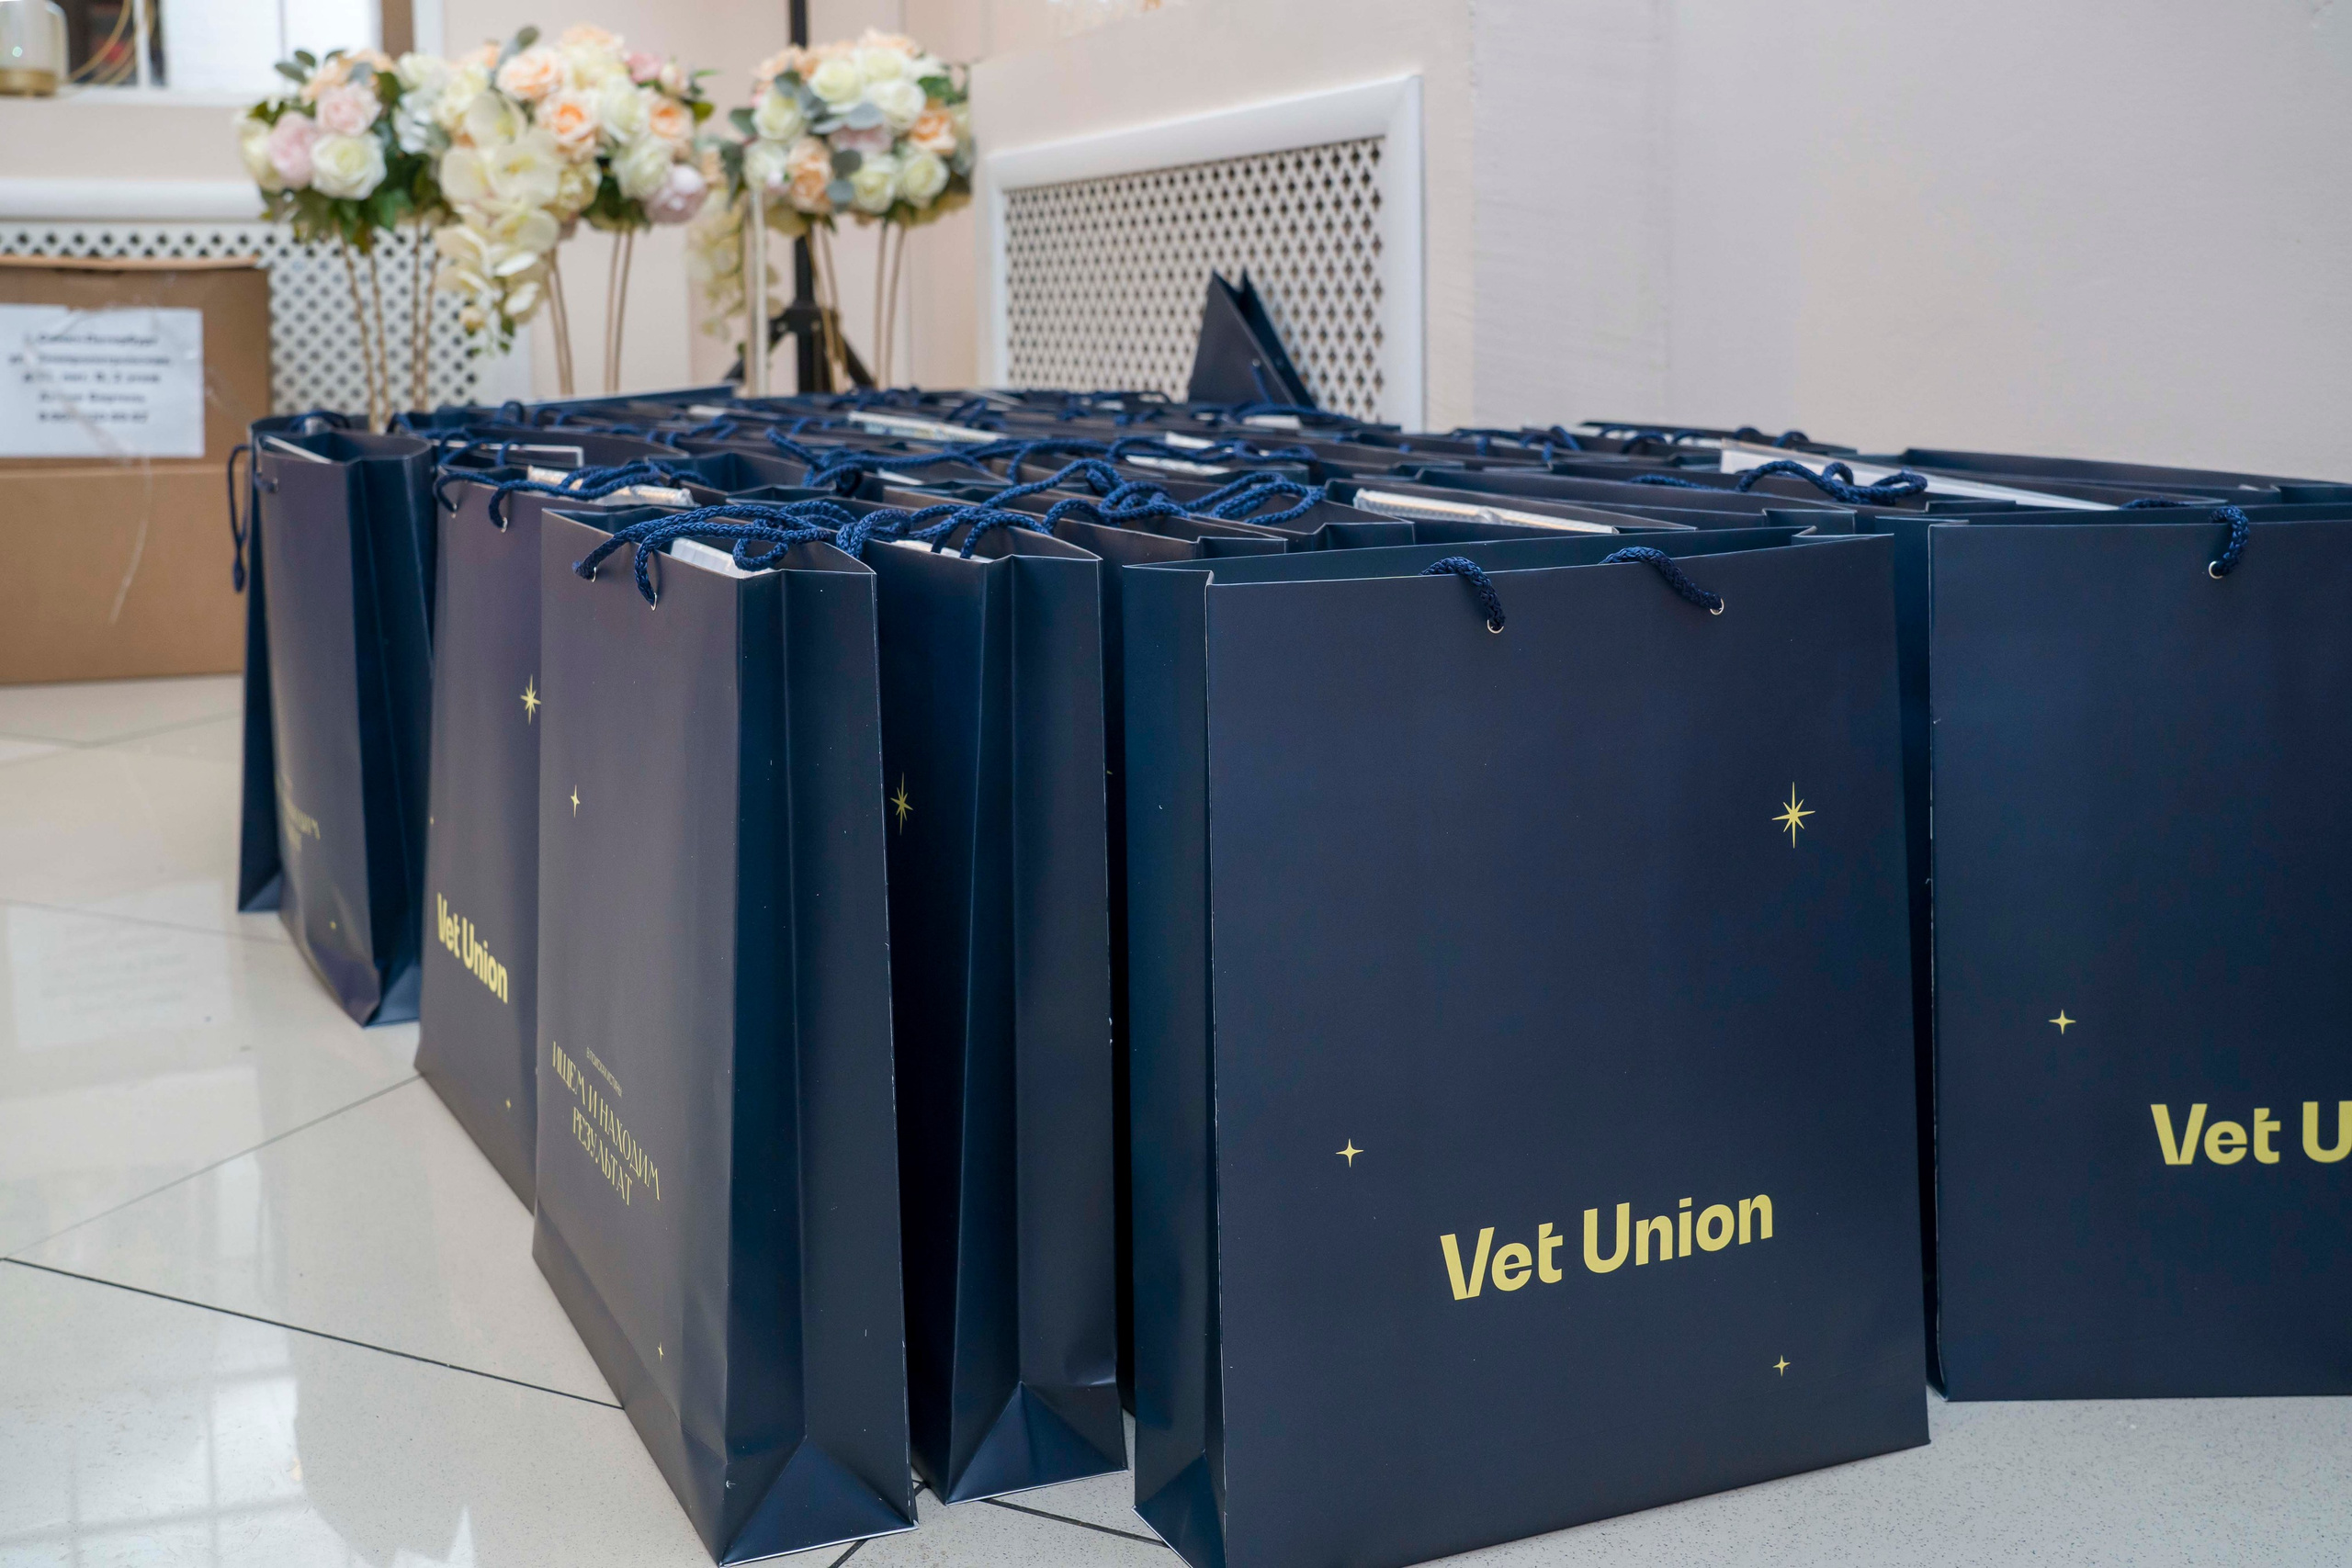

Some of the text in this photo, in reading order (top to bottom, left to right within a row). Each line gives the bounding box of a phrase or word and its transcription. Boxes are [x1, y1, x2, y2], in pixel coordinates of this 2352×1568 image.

[436, 891, 508, 1004] Vet Union
[552, 1041, 661, 1201] ИЩЕМ И НАХОДИМ
[572, 1106, 633, 1206] РЕЗУЛЬТАТ
[2150, 1103, 2281, 1165] Vet
[1440, 1194, 1773, 1301] Vet Union
